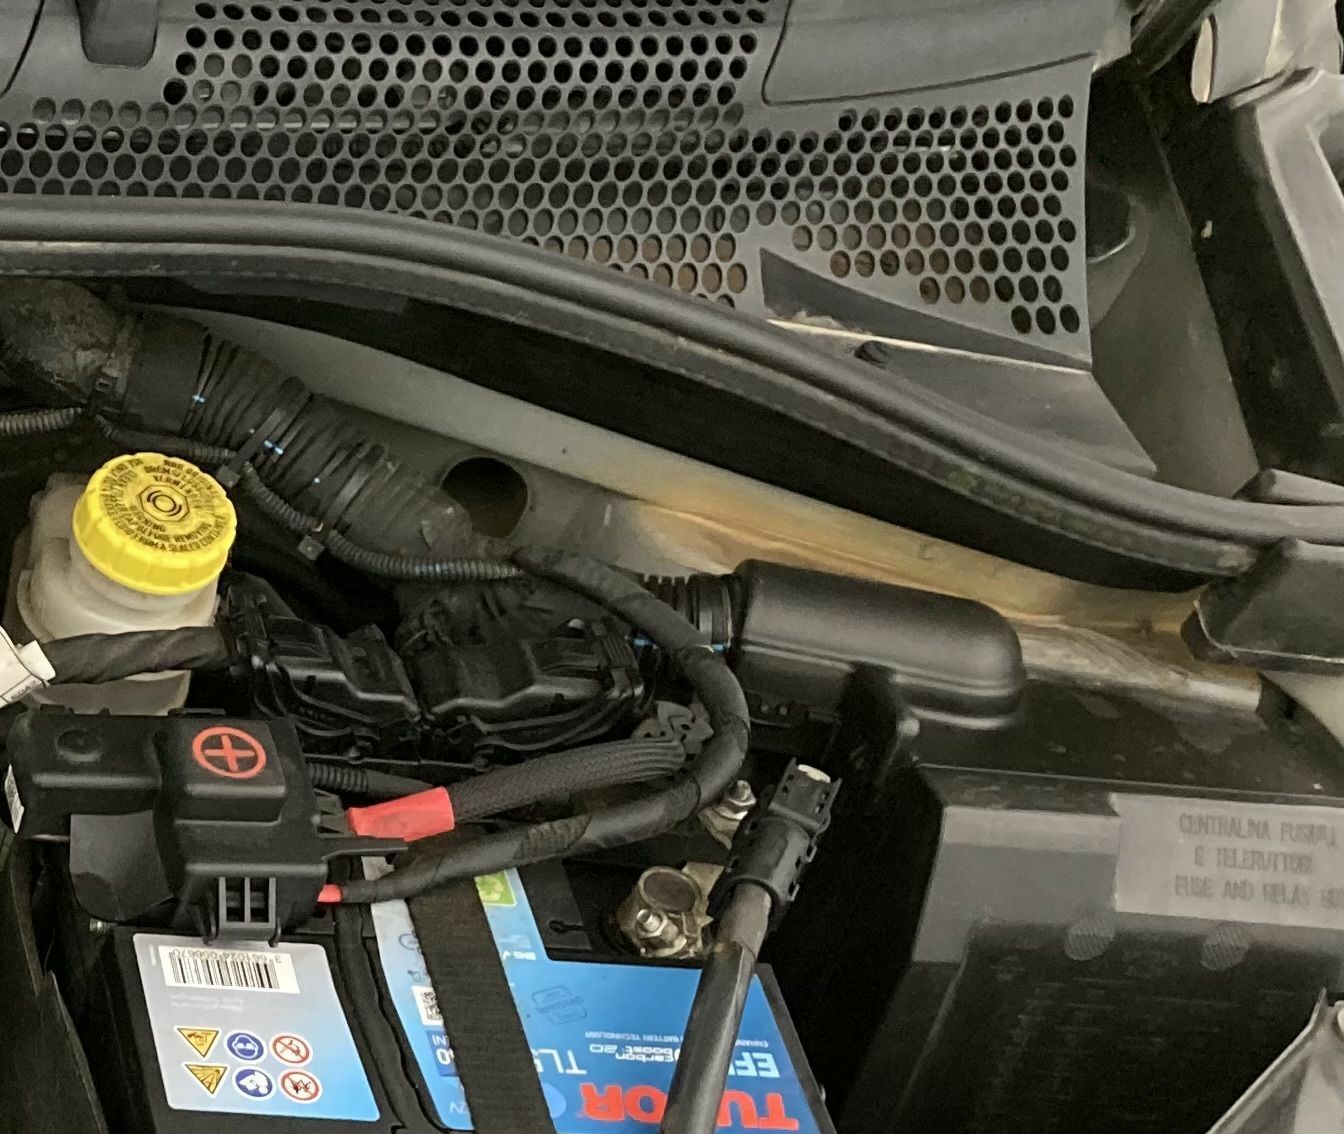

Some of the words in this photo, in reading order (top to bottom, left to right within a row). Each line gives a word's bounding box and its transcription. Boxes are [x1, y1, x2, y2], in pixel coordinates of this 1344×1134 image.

[1179, 812, 1270, 841] CENTRALINA
[1194, 845, 1205, 867] E
[1223, 879, 1256, 902] AND
[615, 1052, 674, 1063] carbon
[624, 1045, 673, 1056] boost
[579, 1082, 799, 1131] TUOR
